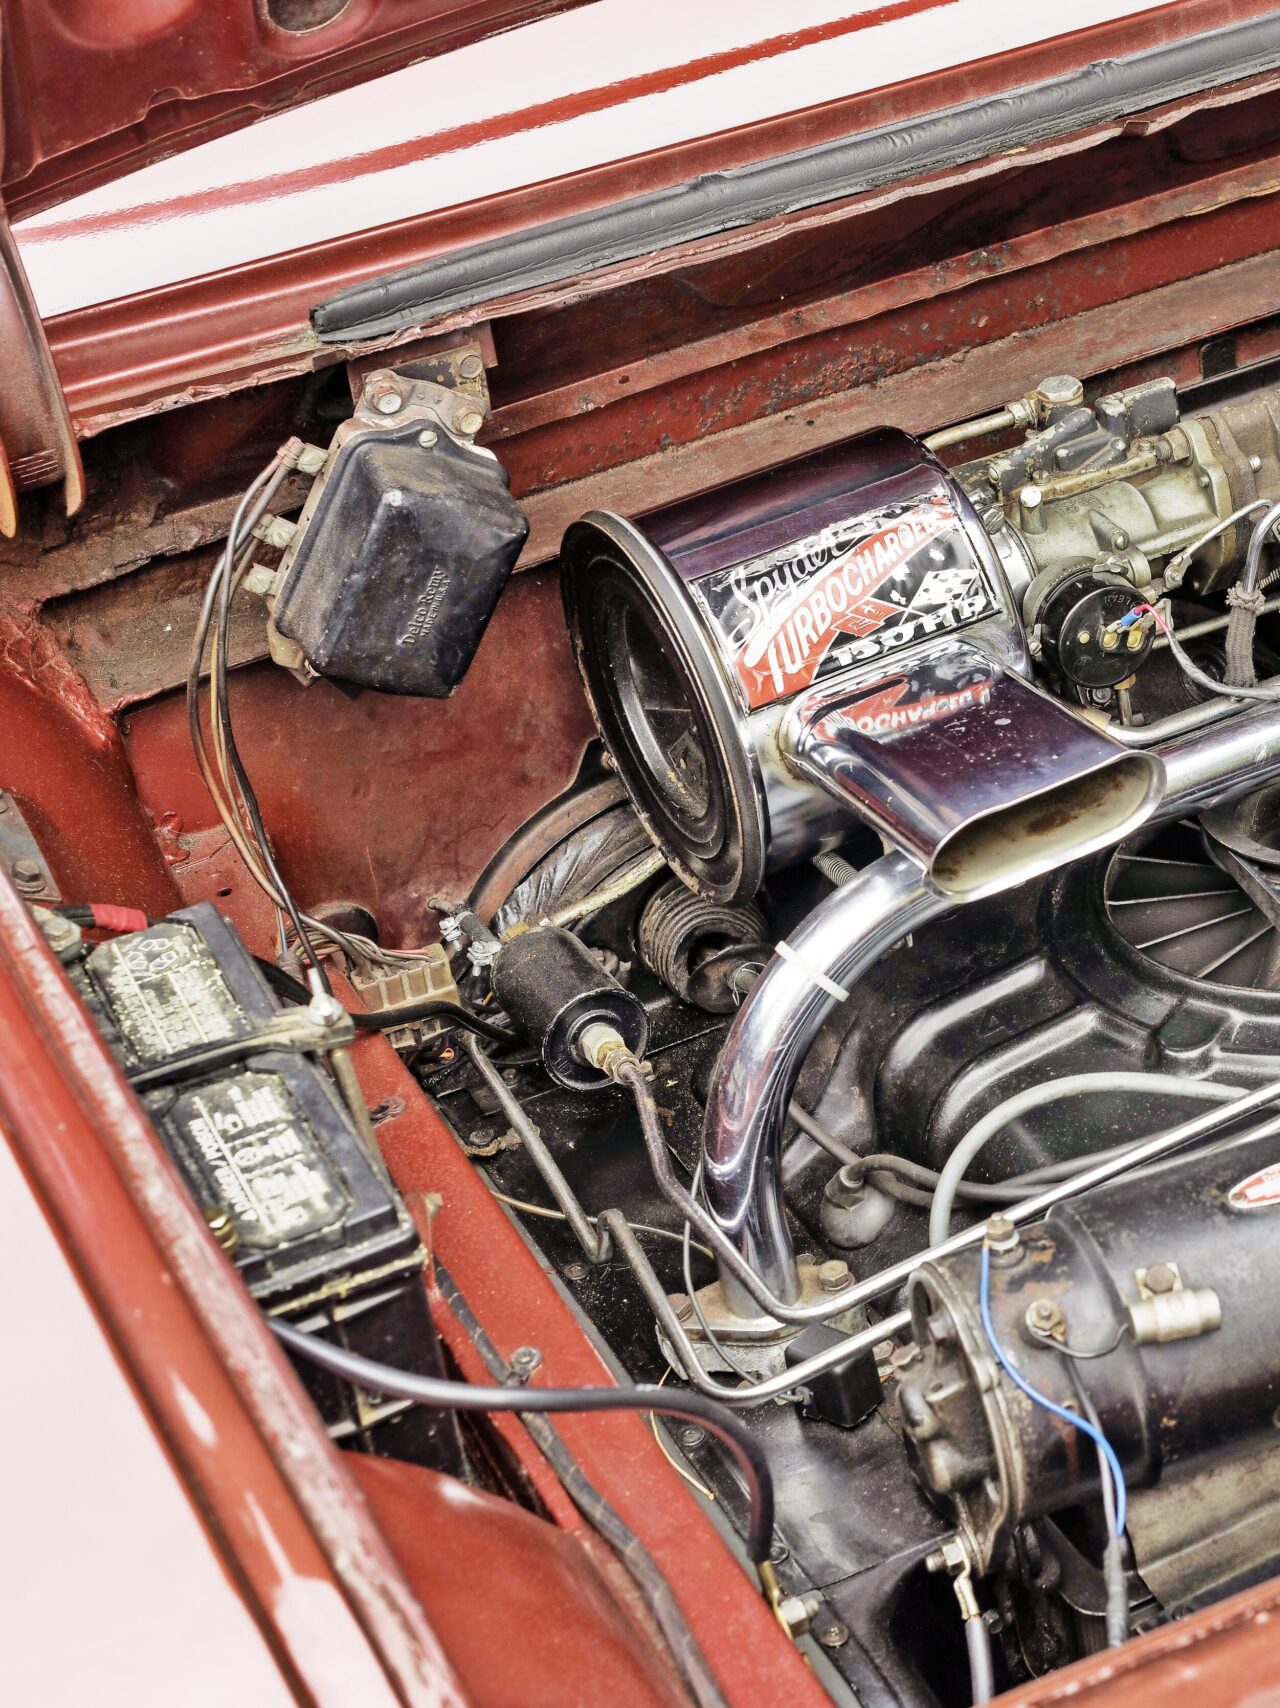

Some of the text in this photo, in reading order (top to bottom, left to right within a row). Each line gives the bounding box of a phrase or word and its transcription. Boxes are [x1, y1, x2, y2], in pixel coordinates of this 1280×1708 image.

[402, 564, 449, 645] Delco Remy
[419, 612, 438, 638] MADE
[726, 528, 876, 648] Spyder
